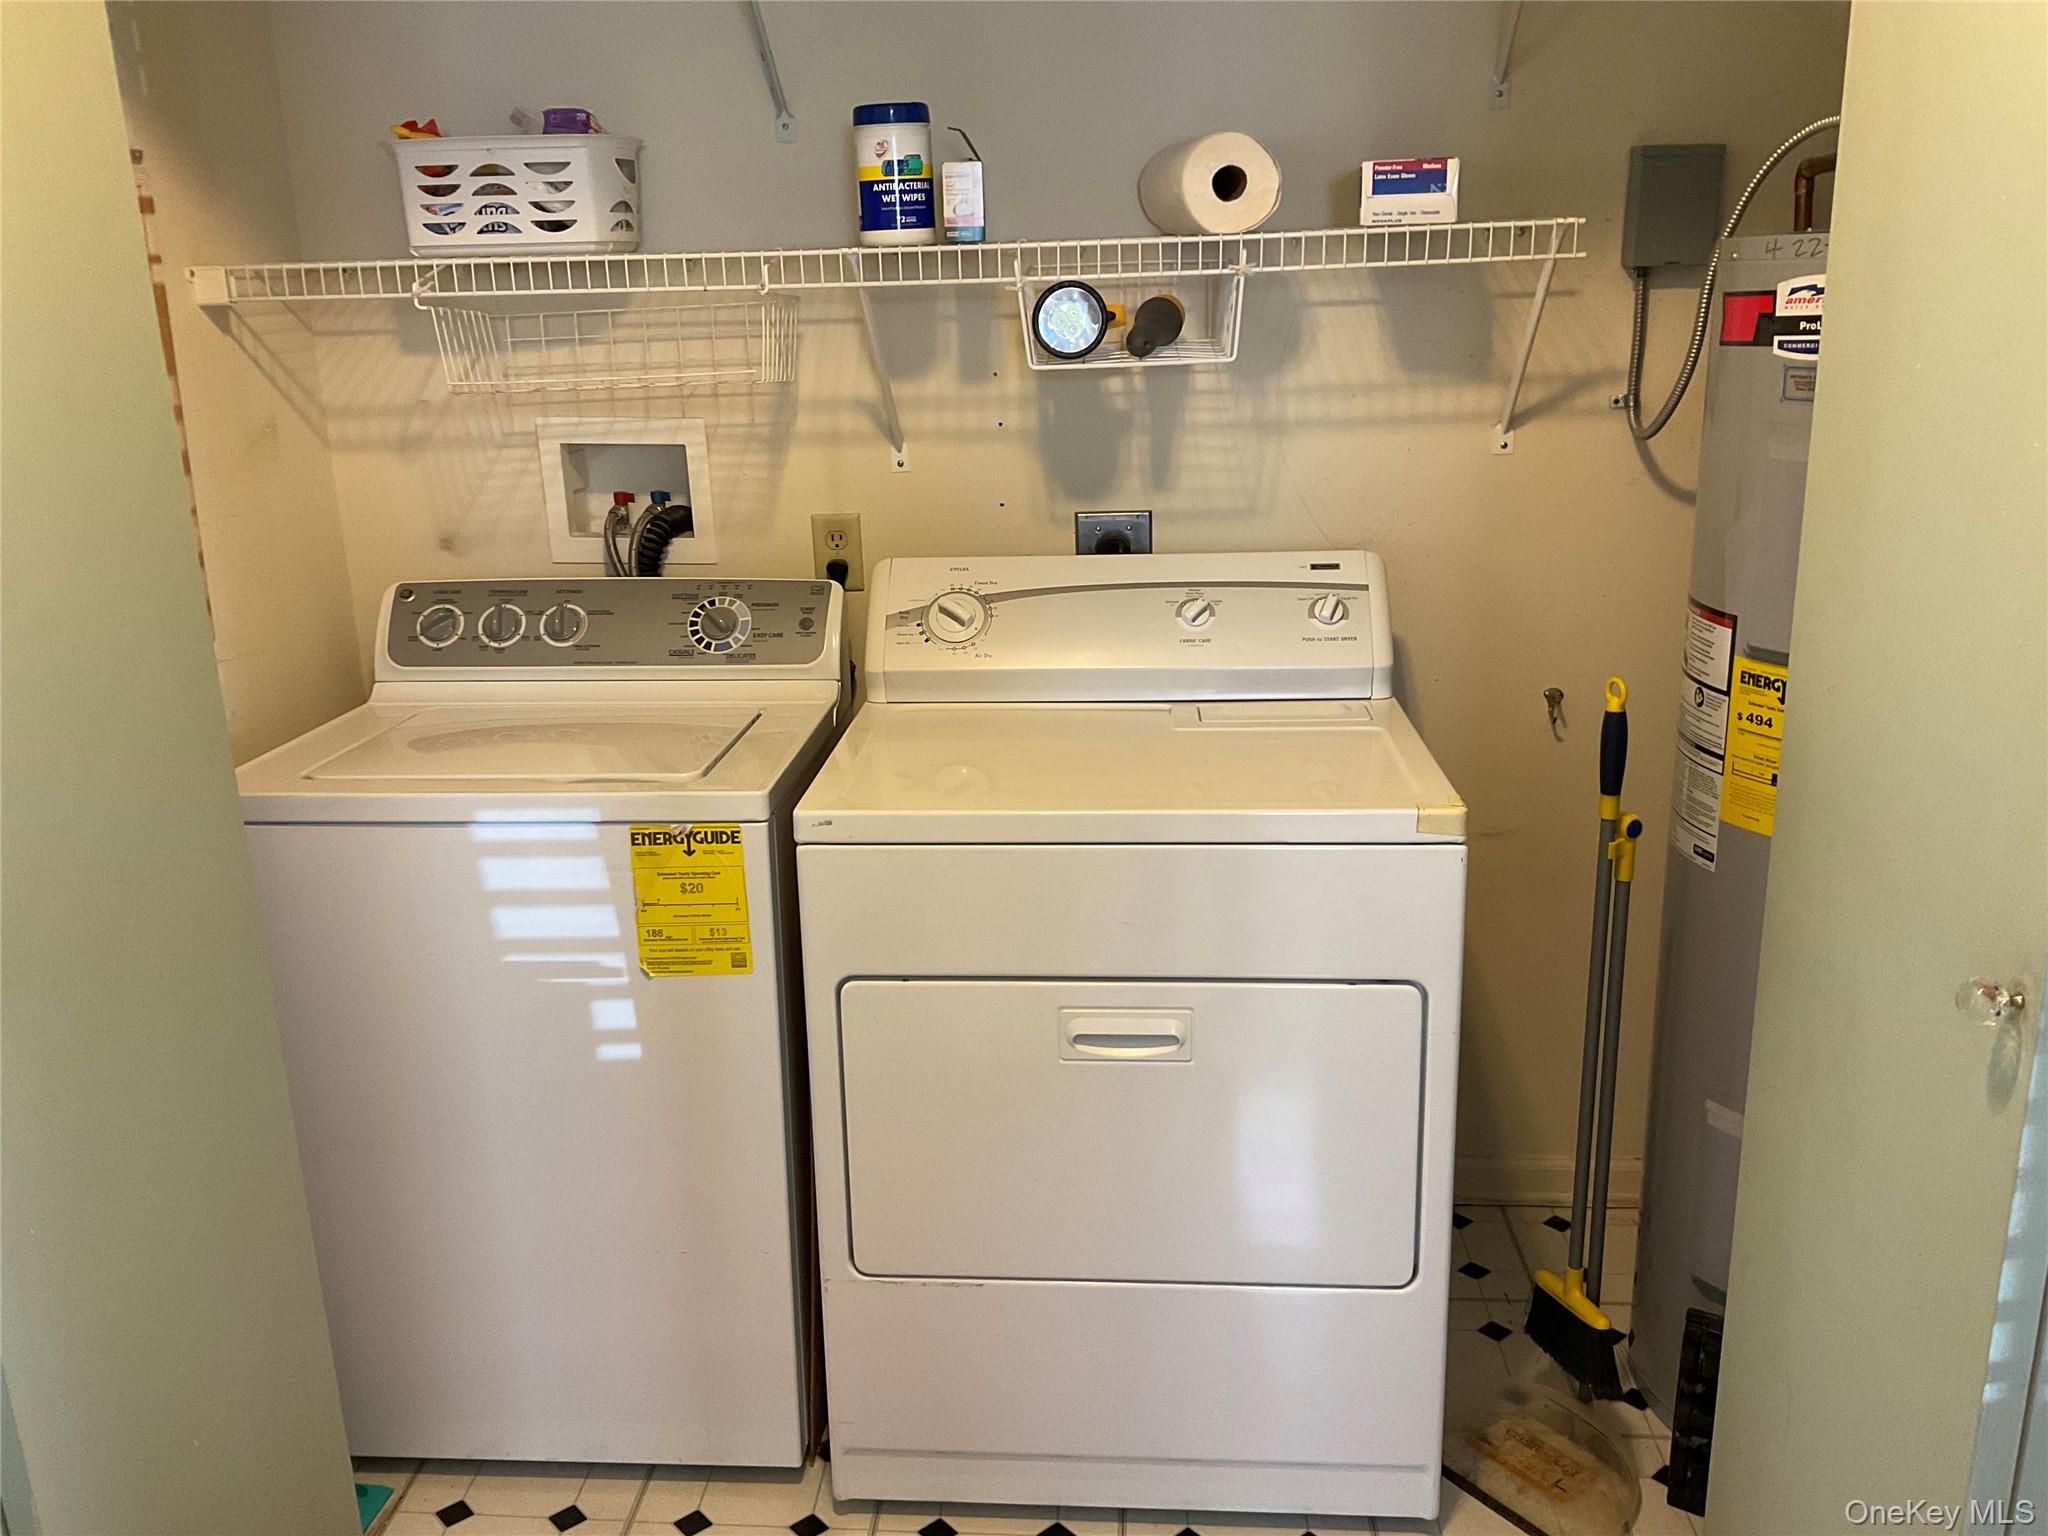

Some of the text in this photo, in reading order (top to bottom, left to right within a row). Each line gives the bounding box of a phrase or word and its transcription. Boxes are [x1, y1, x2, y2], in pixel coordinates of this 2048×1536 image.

[901, 193, 926, 202] WIPES
[1746, 712, 1773, 729] 494
[679, 882, 704, 895] $20
[708, 927, 728, 938] $13
